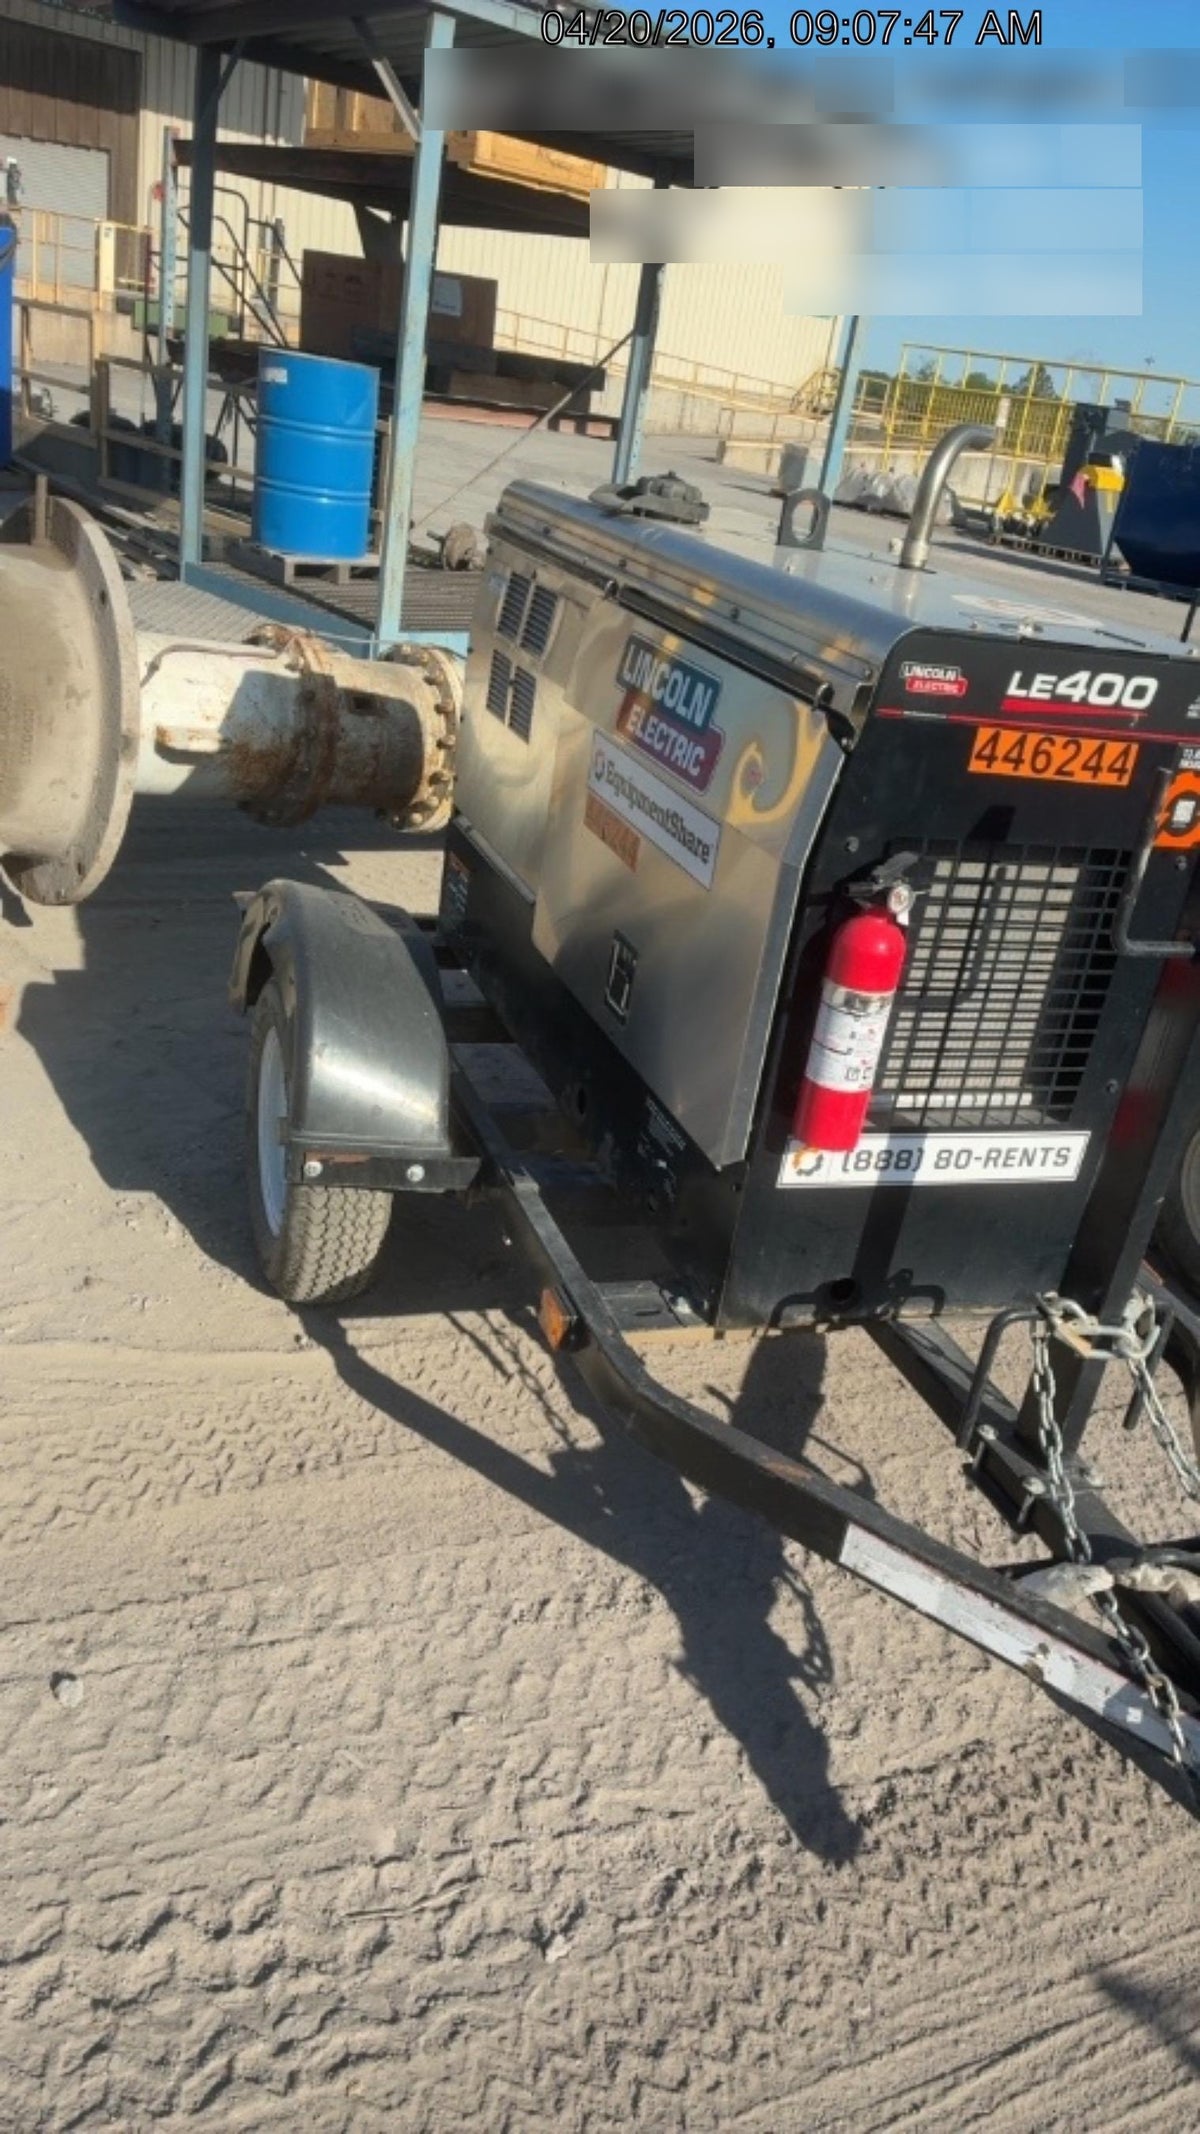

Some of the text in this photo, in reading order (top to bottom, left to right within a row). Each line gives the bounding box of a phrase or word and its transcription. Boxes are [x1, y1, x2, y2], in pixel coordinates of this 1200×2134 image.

[622, 644, 713, 727] LINCOLN
[904, 664, 957, 682] LINCOLN
[912, 679, 960, 695] ELECTRIC
[1005, 669, 1159, 710] LE400
[625, 702, 706, 777] ELECTRIC
[973, 729, 1132, 782] 446244
[606, 759, 711, 865] EquipmentShare
[841, 1146, 1072, 1173] (888) 80-RENTS
